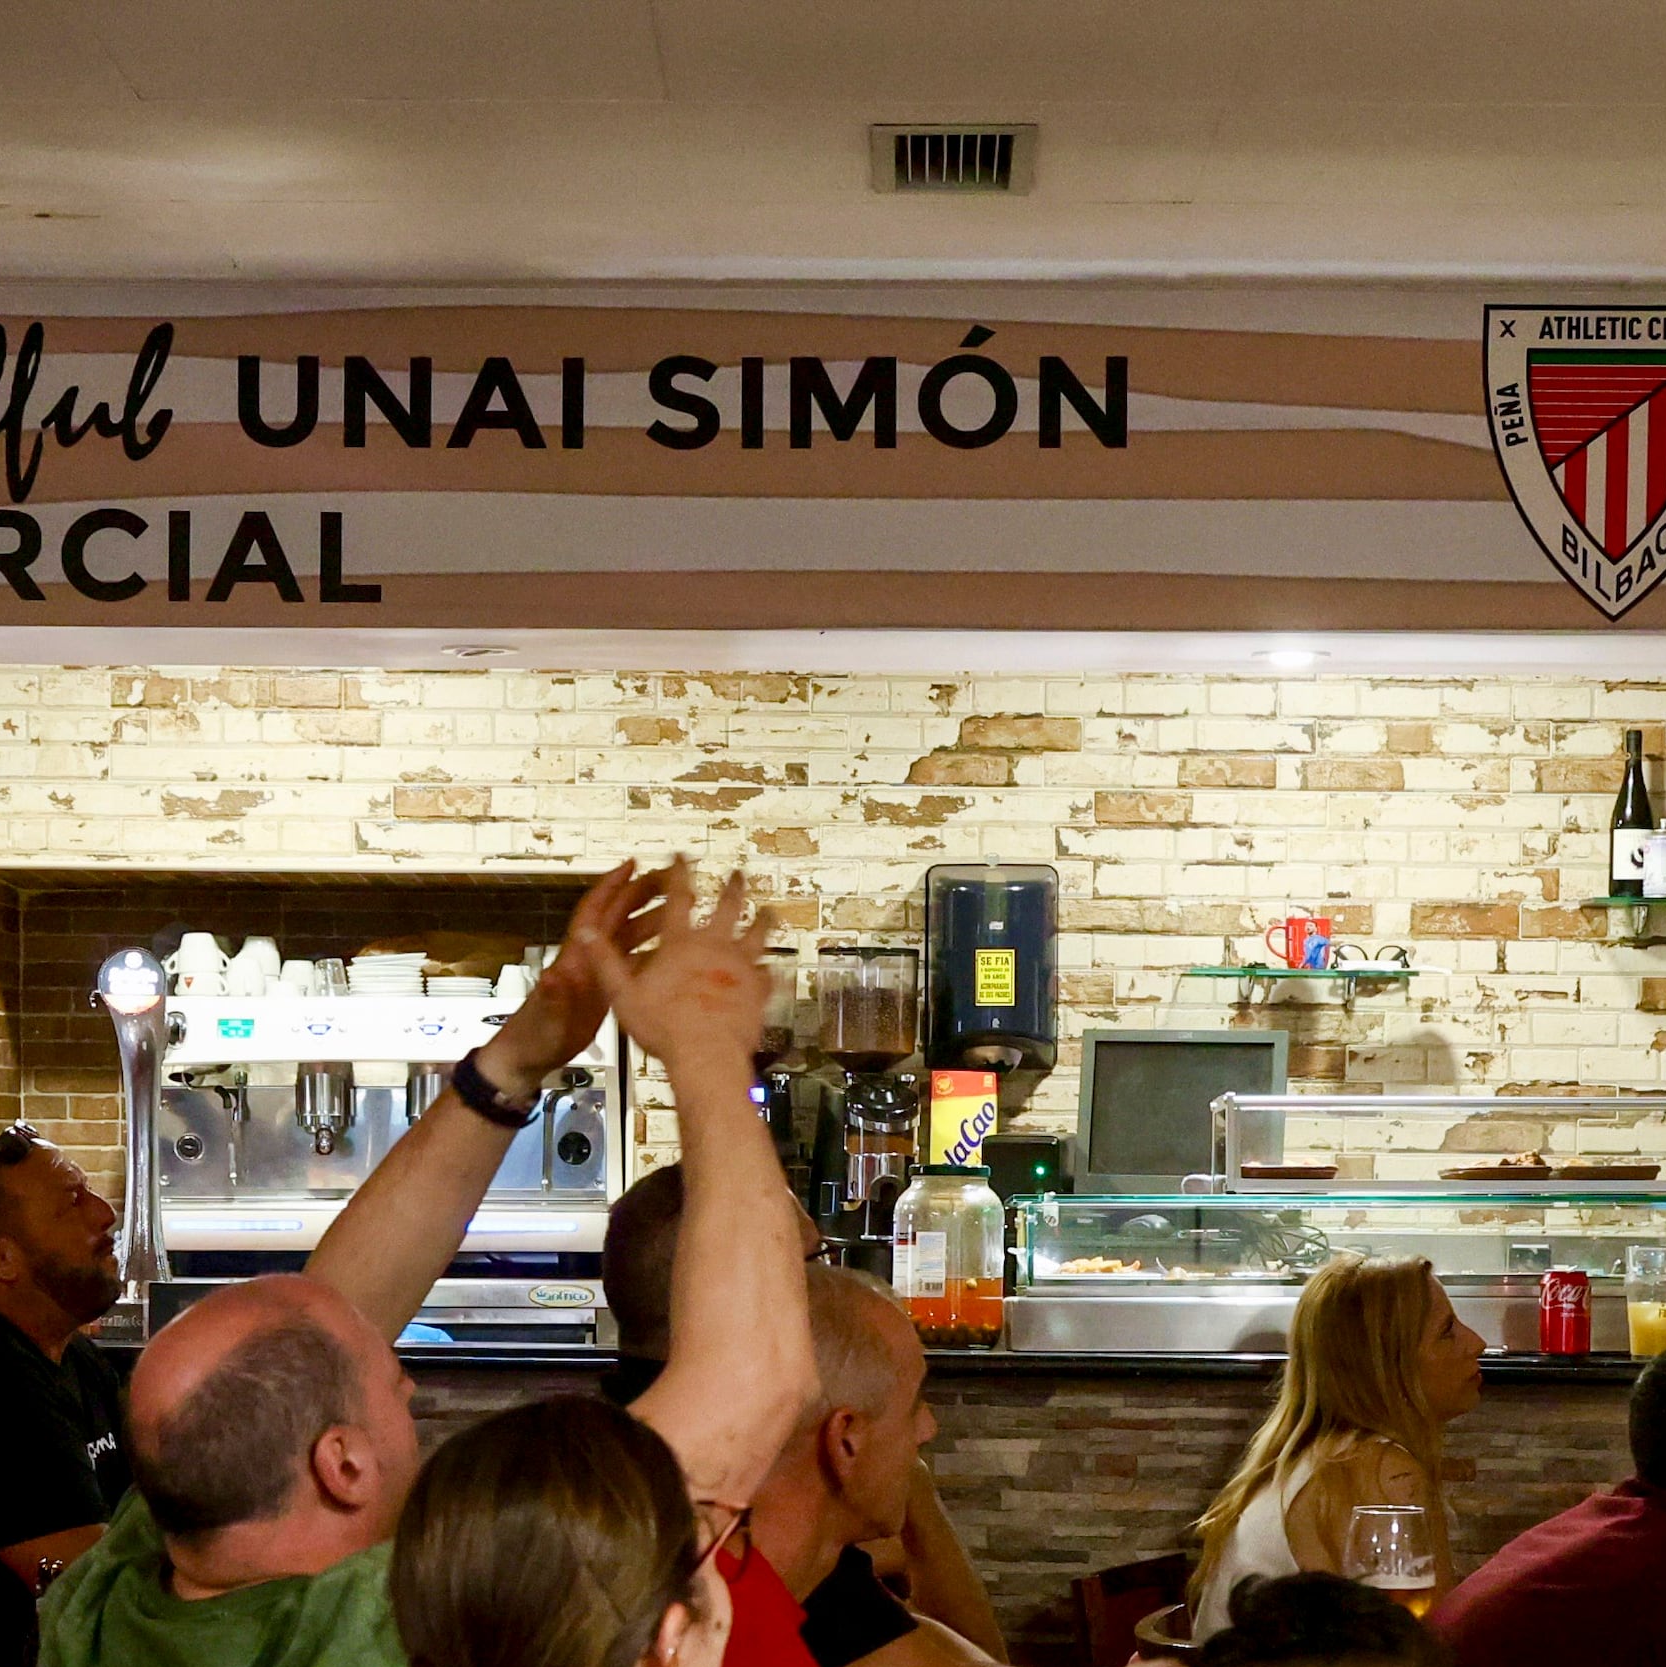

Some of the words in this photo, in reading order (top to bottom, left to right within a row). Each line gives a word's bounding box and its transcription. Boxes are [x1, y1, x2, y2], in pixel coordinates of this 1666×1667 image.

[1538, 316, 1642, 341] ATHLETIC
[237, 355, 585, 450] UNAI
[645, 324, 1129, 451] SIMÓN
[1494, 382, 1529, 447] PEÑA
[980, 956, 992, 966] SE
[943, 1101, 995, 1167] laCao
